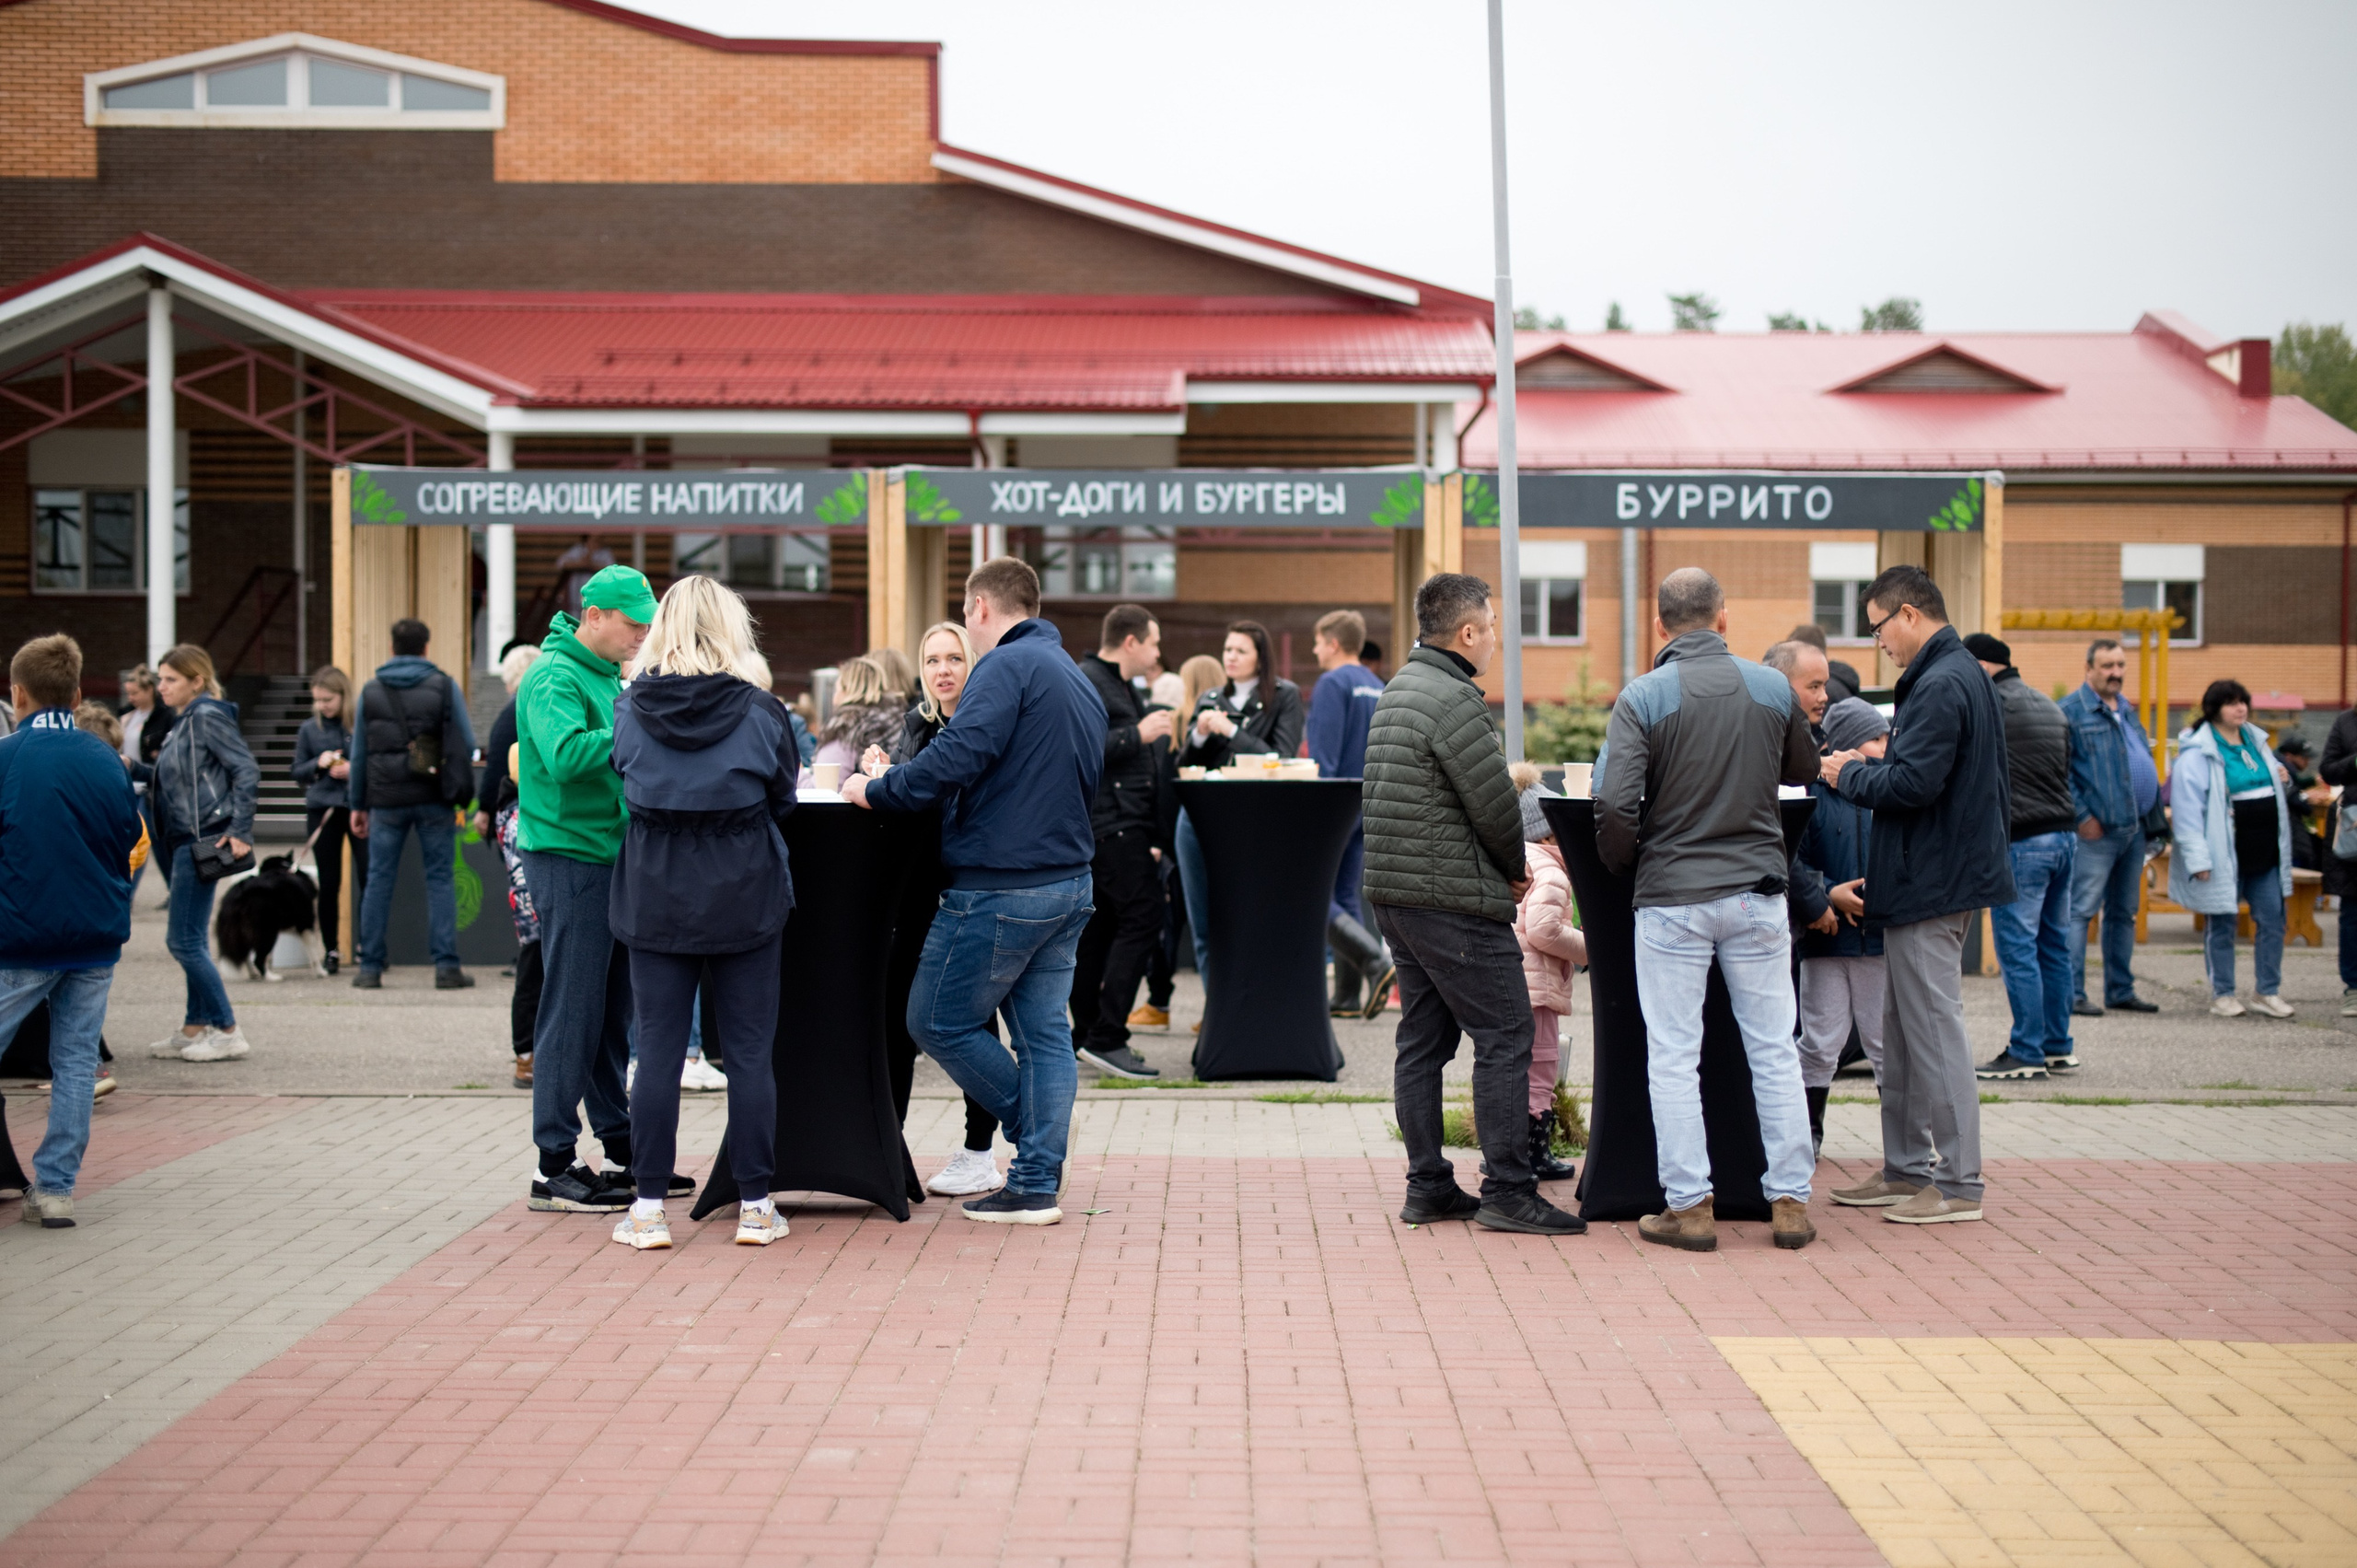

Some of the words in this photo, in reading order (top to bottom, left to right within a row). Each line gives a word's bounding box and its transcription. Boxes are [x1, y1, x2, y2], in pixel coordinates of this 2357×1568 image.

[417, 482, 643, 520] СОГРЕВАЮЩИЕ
[650, 482, 804, 515] НАПИТКИ
[990, 481, 1146, 518] ХОТ-ДОГИ
[1158, 482, 1184, 514] И
[1195, 482, 1347, 515] БУРГЕРЫ
[1616, 482, 1833, 520] БУРРИТО
